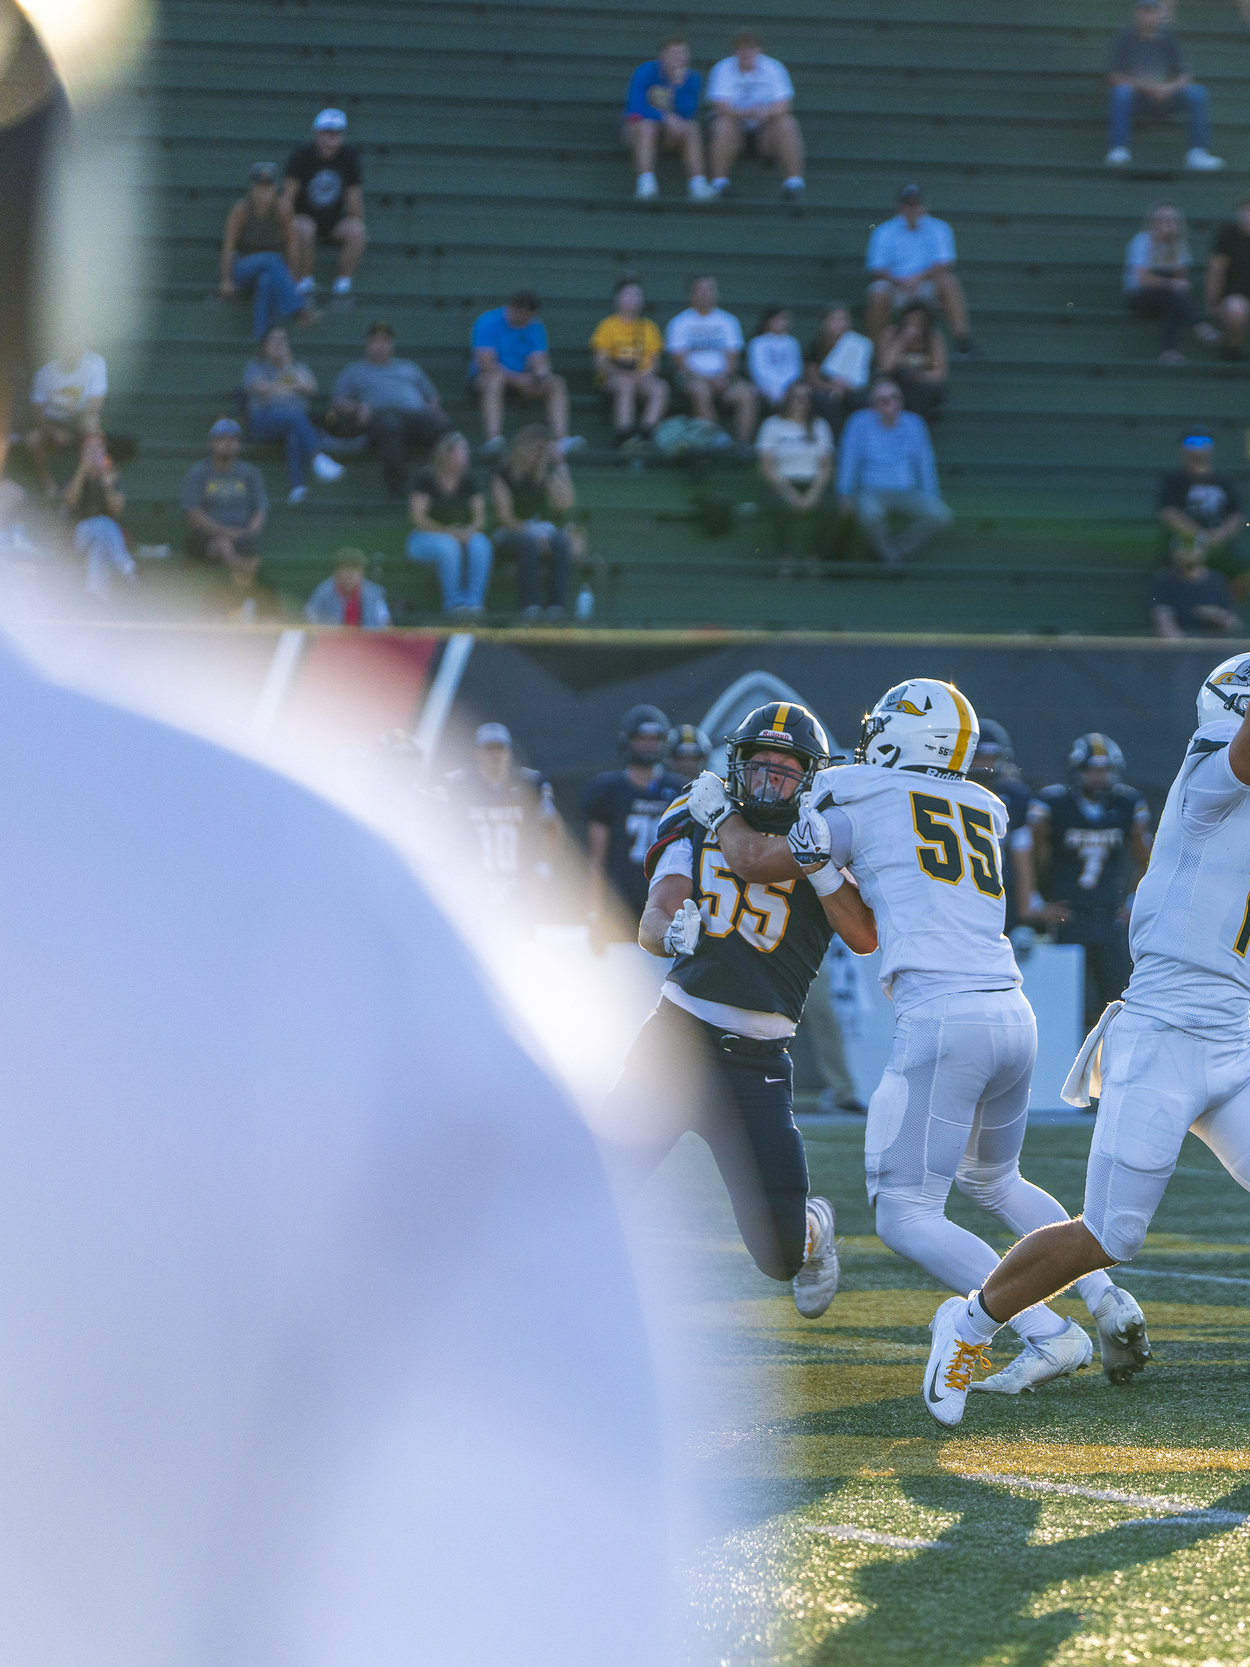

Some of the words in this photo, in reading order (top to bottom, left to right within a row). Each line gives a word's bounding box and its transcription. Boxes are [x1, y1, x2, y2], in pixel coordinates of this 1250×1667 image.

[938, 746, 950, 756] 55
[908, 791, 1005, 900] 55
[1078, 844, 1108, 890] 7
[698, 848, 791, 953] 55
